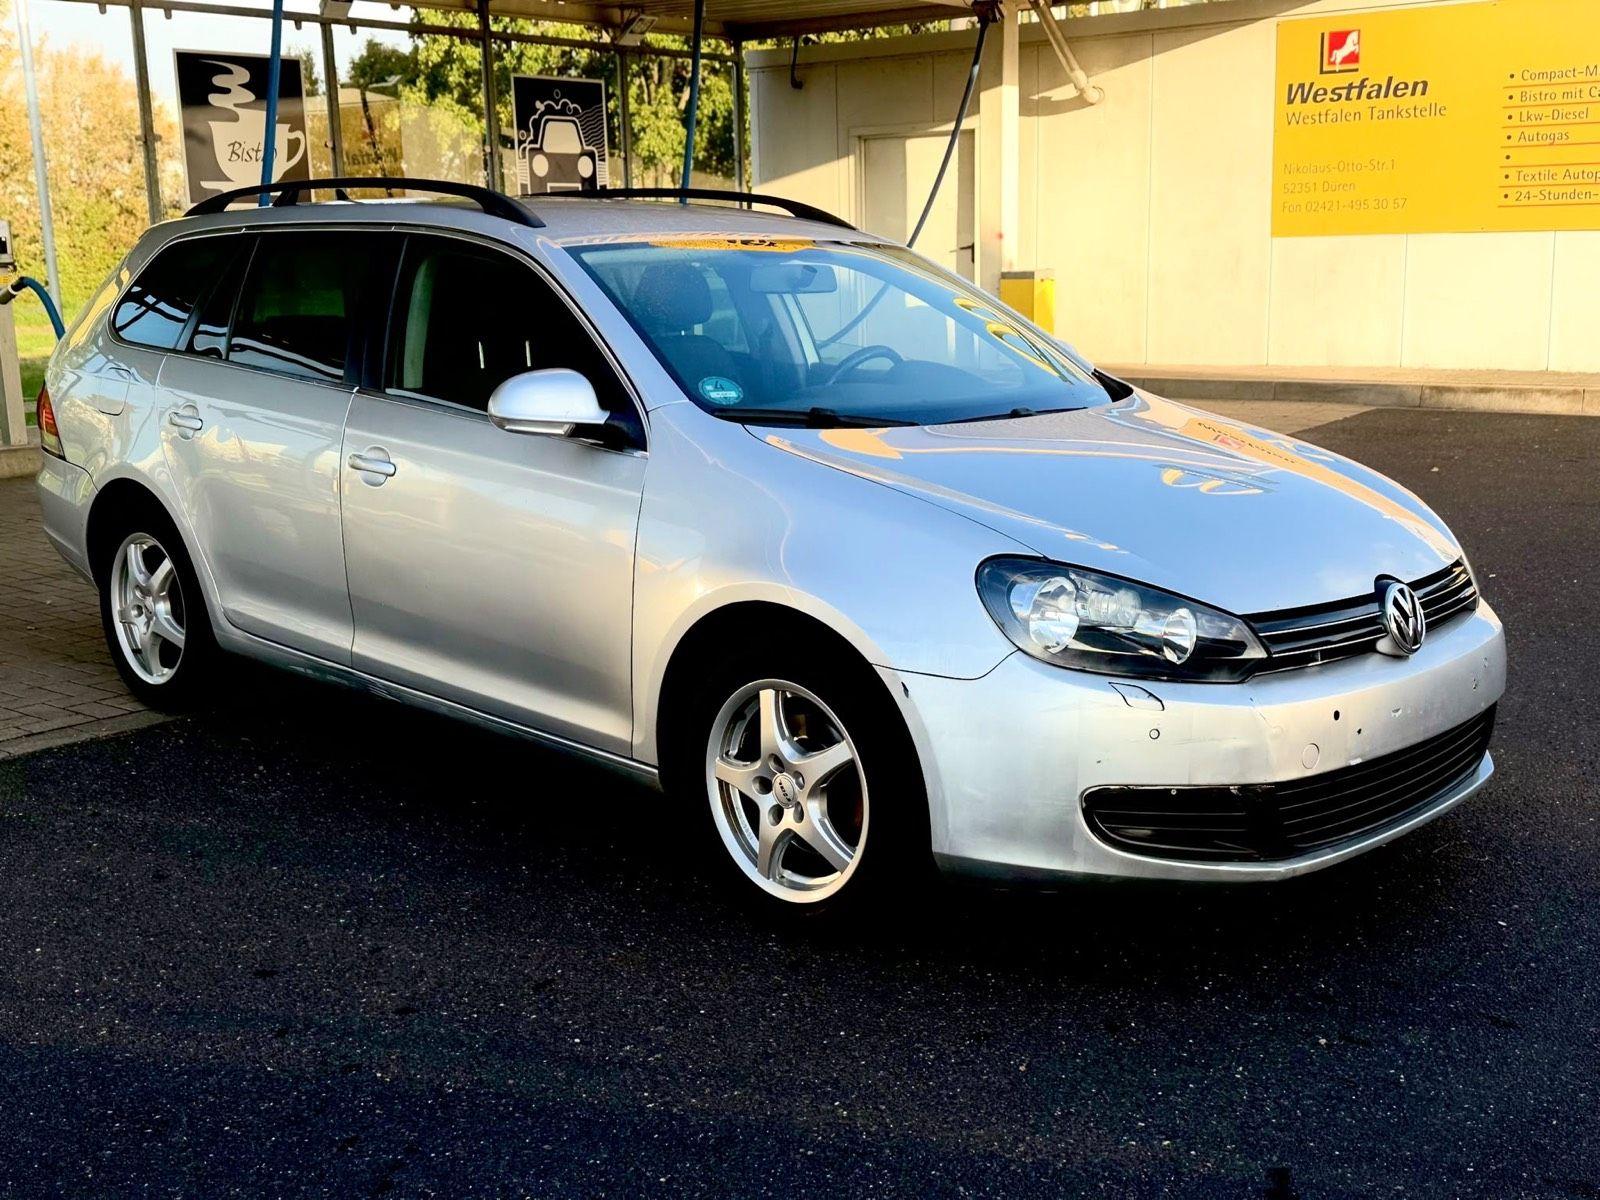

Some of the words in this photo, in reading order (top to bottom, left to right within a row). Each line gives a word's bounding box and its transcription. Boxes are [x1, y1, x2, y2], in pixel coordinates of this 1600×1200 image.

[1521, 64, 1600, 82] Compact-M
[1286, 76, 1429, 105] Westfalen
[1520, 90, 1557, 103] Bistro
[1562, 87, 1584, 100] mit
[1286, 107, 1362, 126] Westfalen
[1368, 102, 1447, 121] Tankstelle
[1519, 107, 1589, 122] Lkw-Diesel
[1518, 131, 1570, 145] Autogas
[227, 140, 277, 162] Bist
[1516, 168, 1558, 182] Textile
[1283, 182, 1317, 194] 52351
[1282, 201, 1301, 213] Fon
[1373, 198, 1389, 210] 30
[1393, 197, 1408, 210] 57
